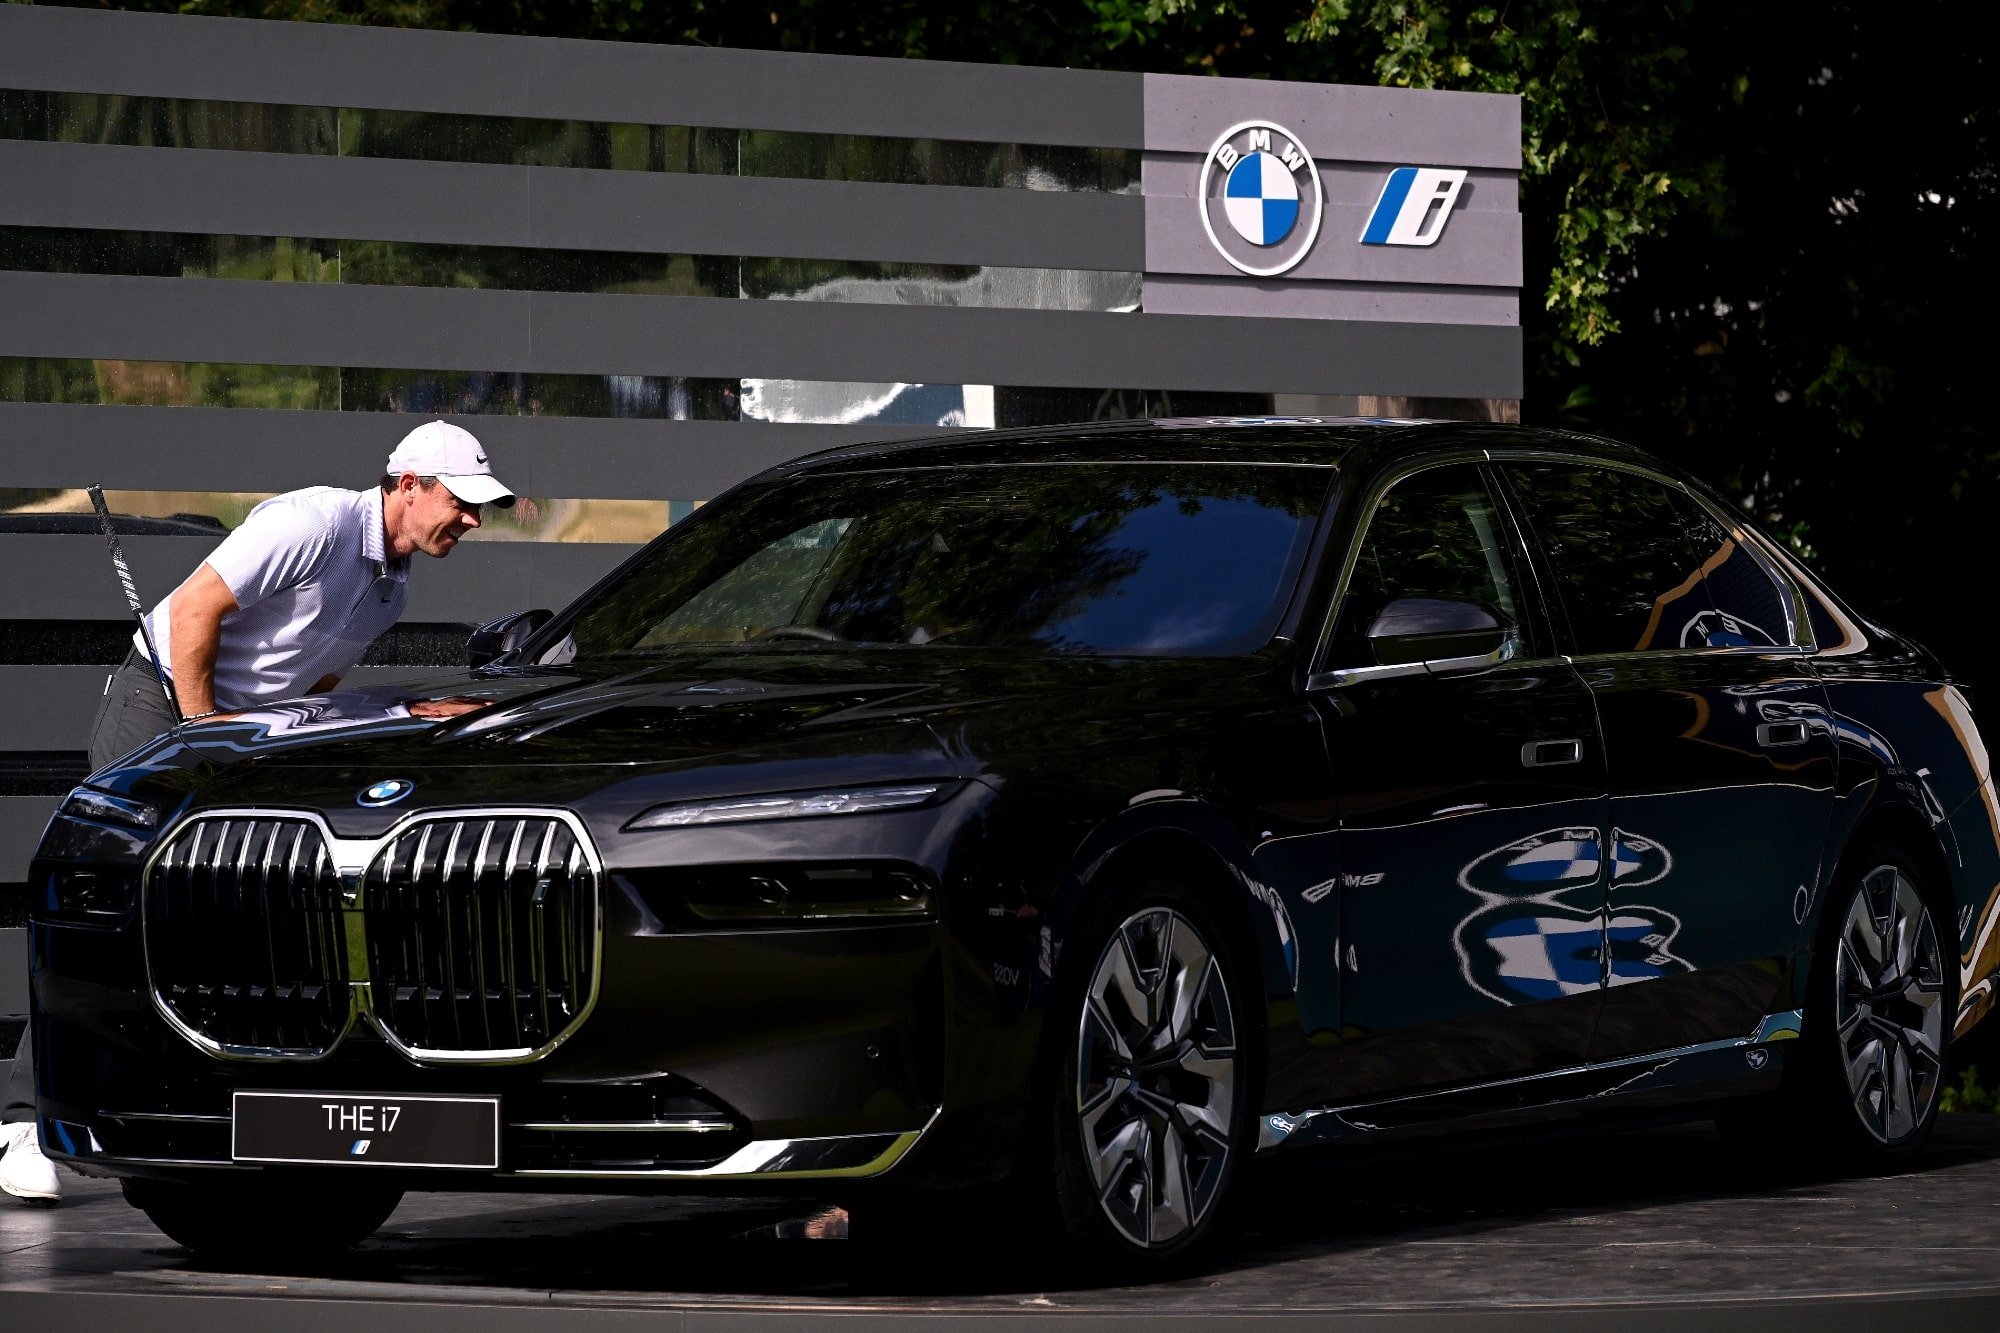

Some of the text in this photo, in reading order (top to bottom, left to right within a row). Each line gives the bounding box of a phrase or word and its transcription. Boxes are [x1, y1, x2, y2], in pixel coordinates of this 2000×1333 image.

[1216, 130, 1305, 171] BMW
[322, 1105, 401, 1132] THE i7
